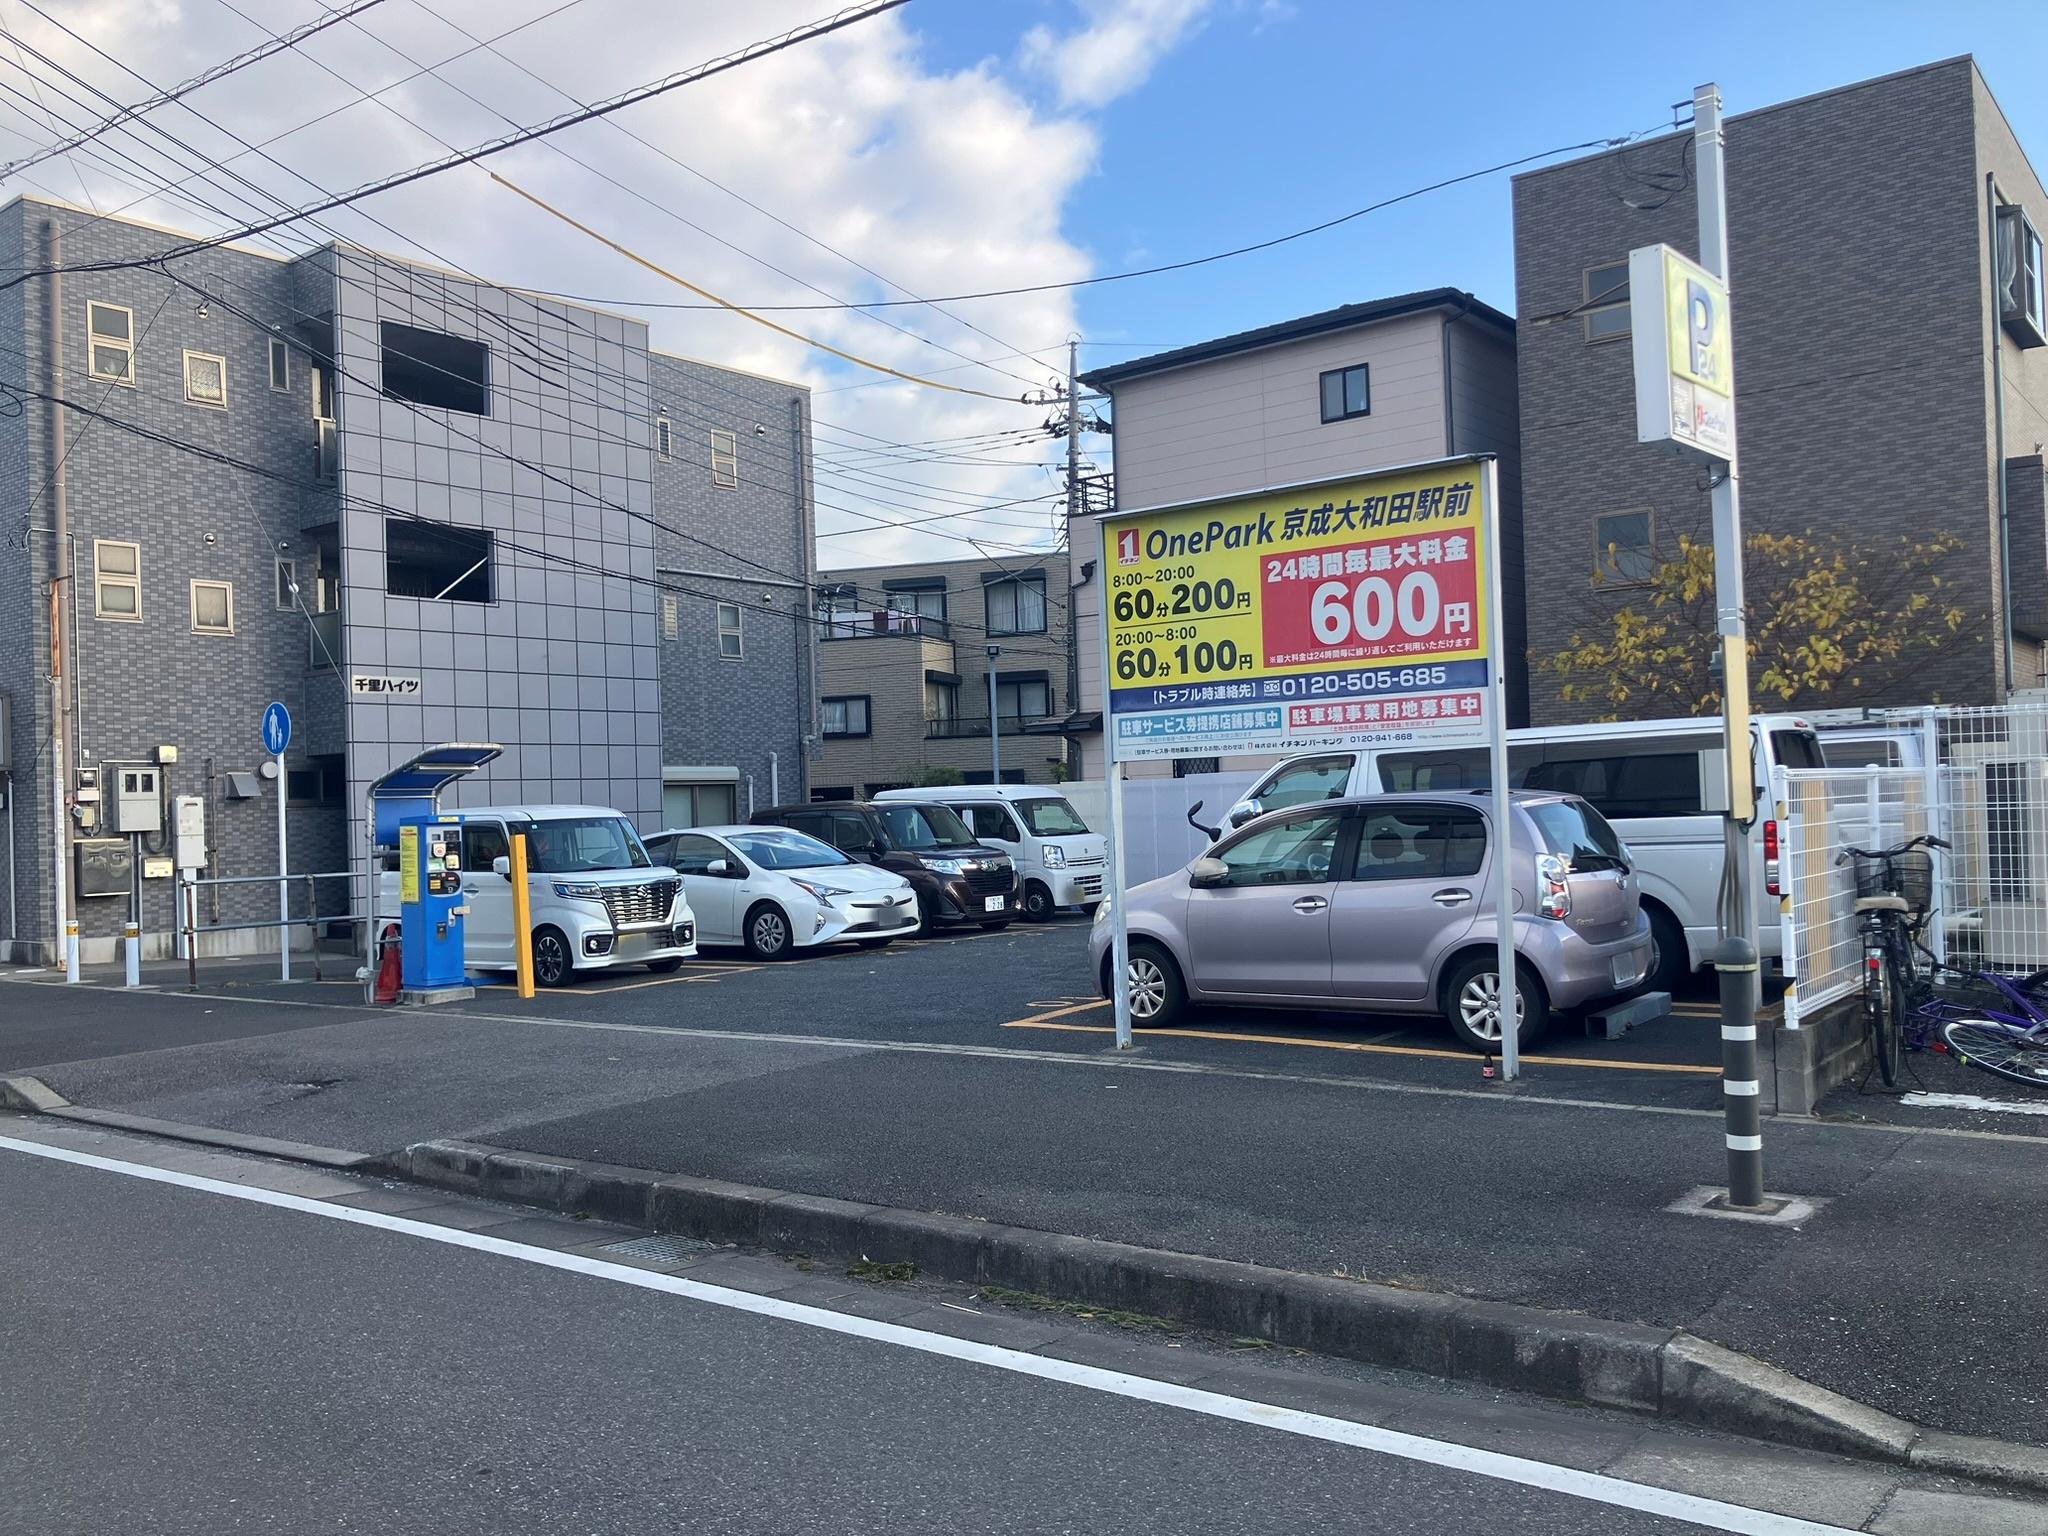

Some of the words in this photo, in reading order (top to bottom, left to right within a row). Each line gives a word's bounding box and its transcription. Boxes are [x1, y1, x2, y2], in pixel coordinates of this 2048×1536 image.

[1687, 278, 1715, 375] P
[1698, 350, 1717, 384] 24
[1145, 511, 1275, 560] OnePark
[1280, 482, 1474, 540] 京成大和田駅前
[1267, 536, 1469, 583] 24時間毎最大料金
[1311, 571, 1471, 645] 600円
[355, 678, 419, 693] 千里ハイツ
[1282, 666, 1447, 696] 0120-505-685
[1292, 696, 1478, 725] 駐車場事業用地募集中
[1350, 733, 1413, 743] 0120-941-668
